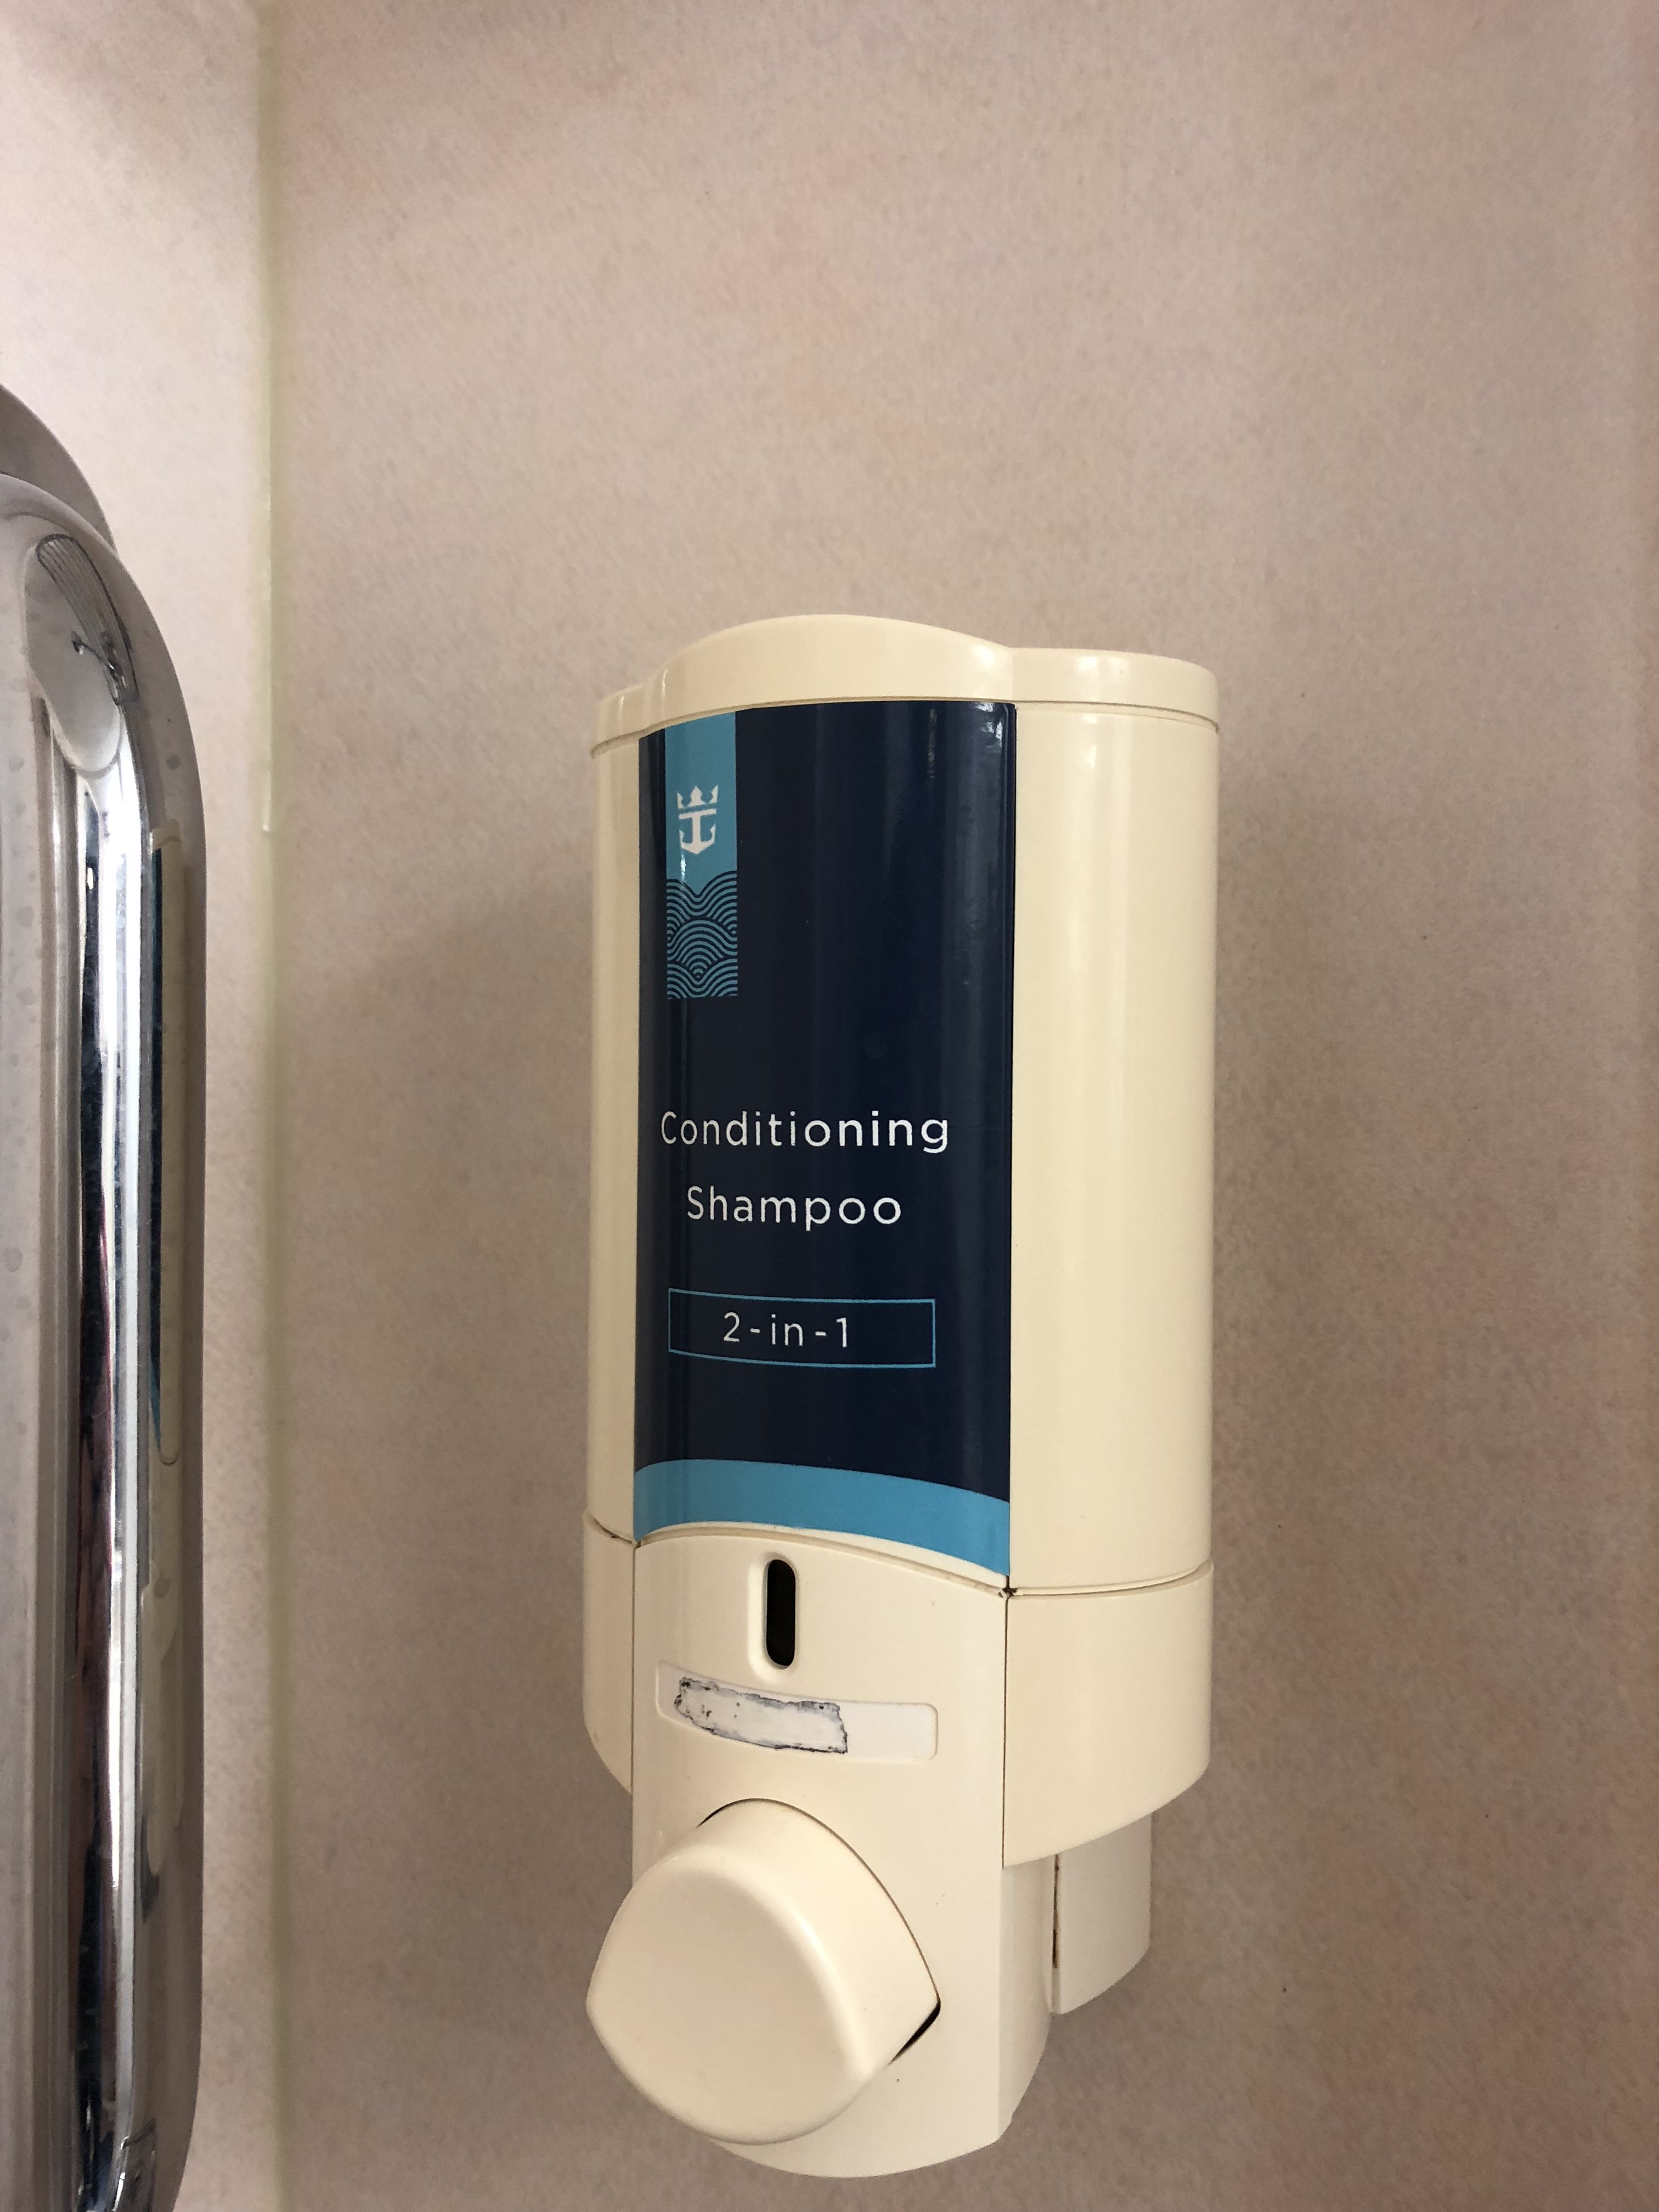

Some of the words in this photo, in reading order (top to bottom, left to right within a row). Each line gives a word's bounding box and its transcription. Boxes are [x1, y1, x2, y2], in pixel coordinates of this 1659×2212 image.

[661, 1110, 948, 1154] Conditioning
[687, 1184, 901, 1232] Shampoo
[723, 1312, 848, 1348] 2-in-1
